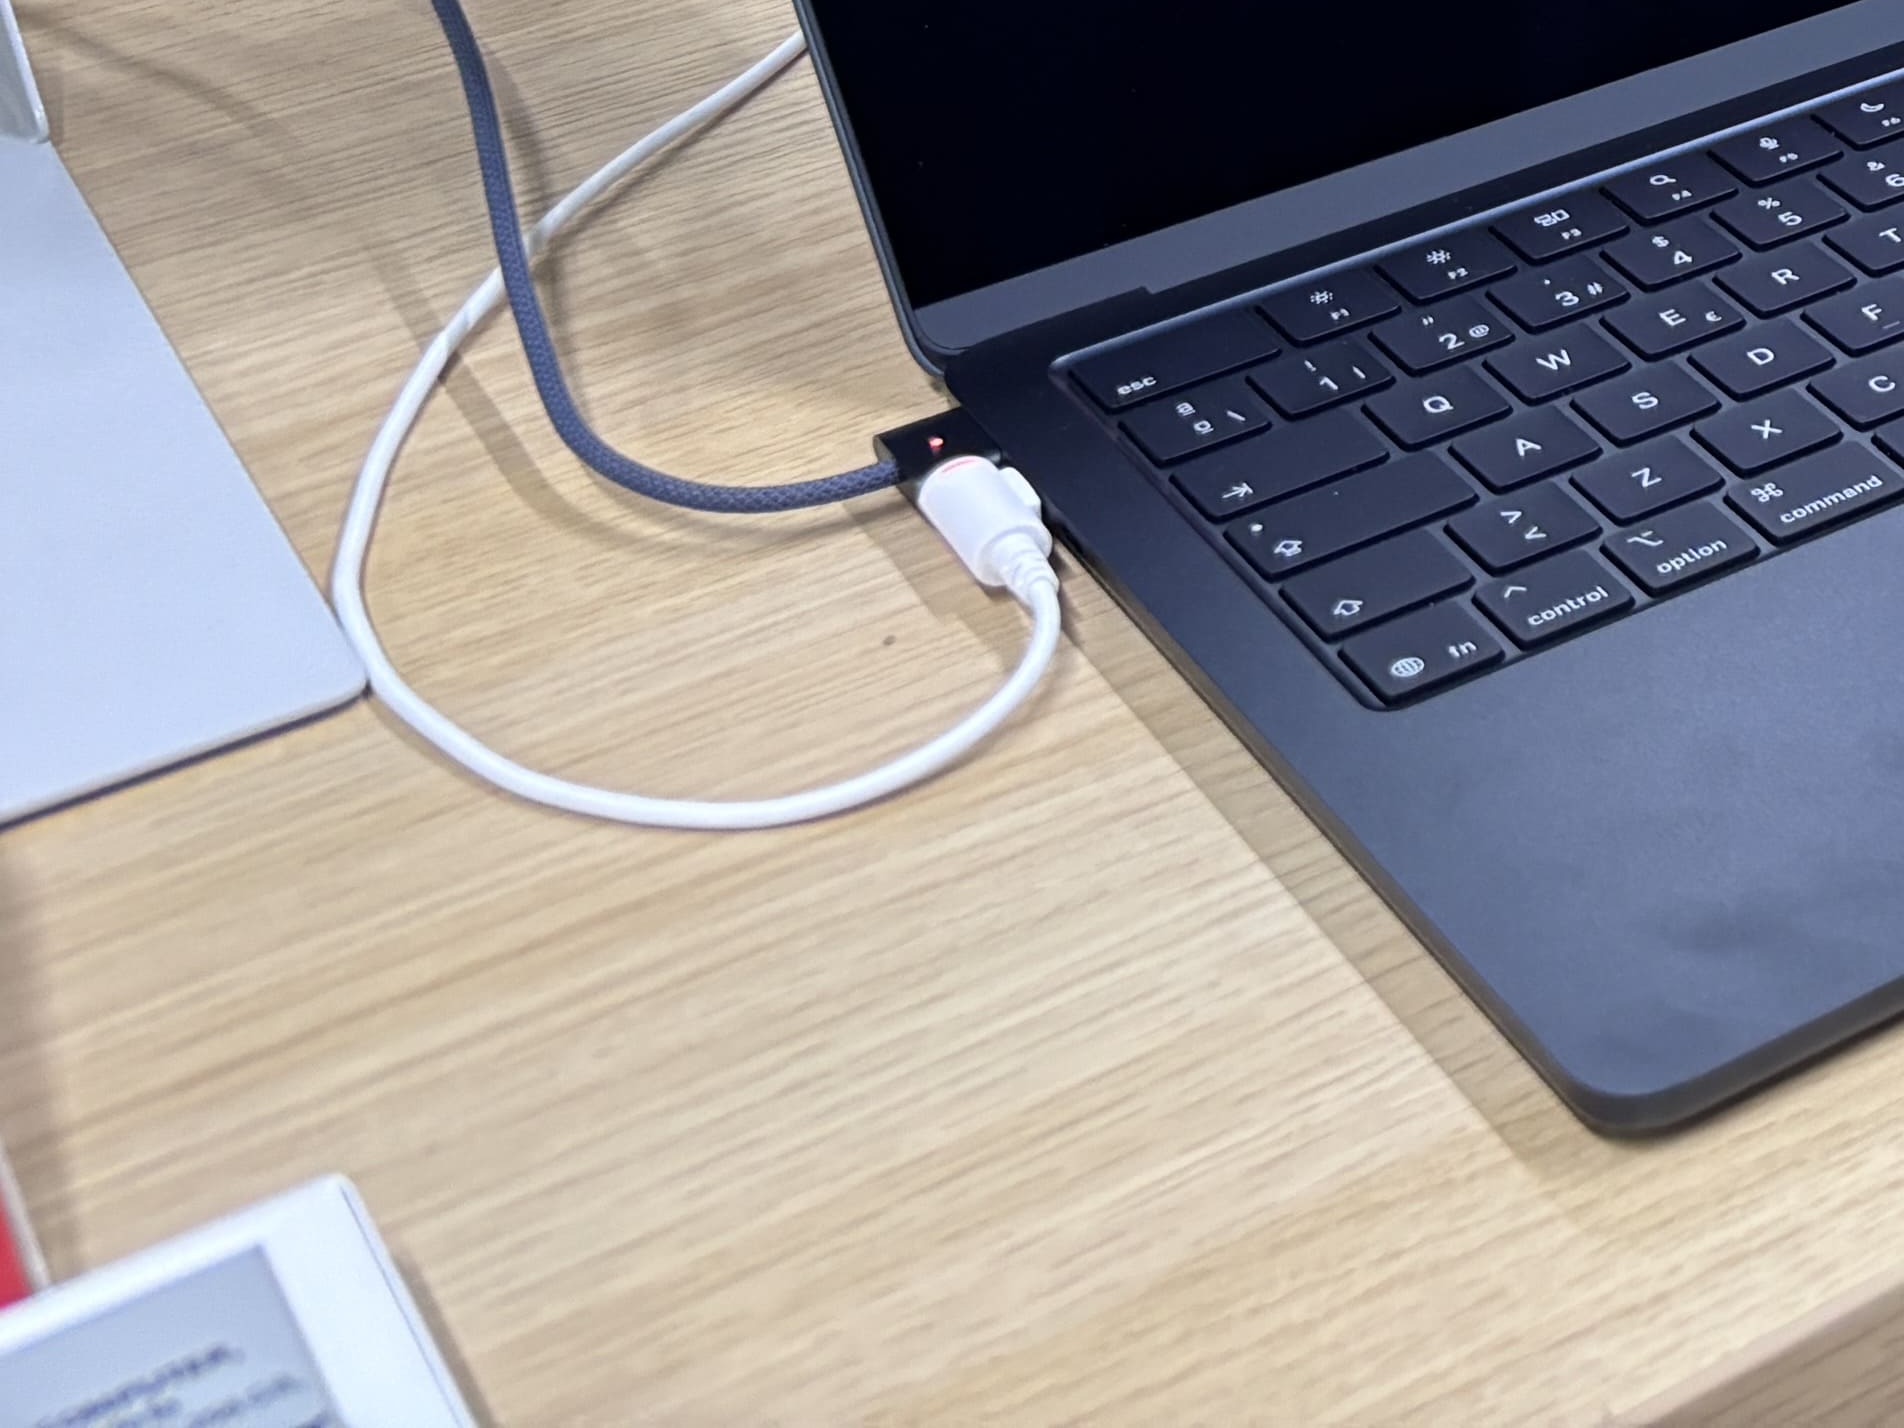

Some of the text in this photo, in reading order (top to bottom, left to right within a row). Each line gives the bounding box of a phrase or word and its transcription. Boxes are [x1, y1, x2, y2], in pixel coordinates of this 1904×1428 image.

[1117, 375, 1157, 395] esc
[1780, 475, 1883, 524] command
[1652, 536, 1730, 579] option
[1527, 585, 1609, 626] control
[1448, 639, 1477, 658] fn
